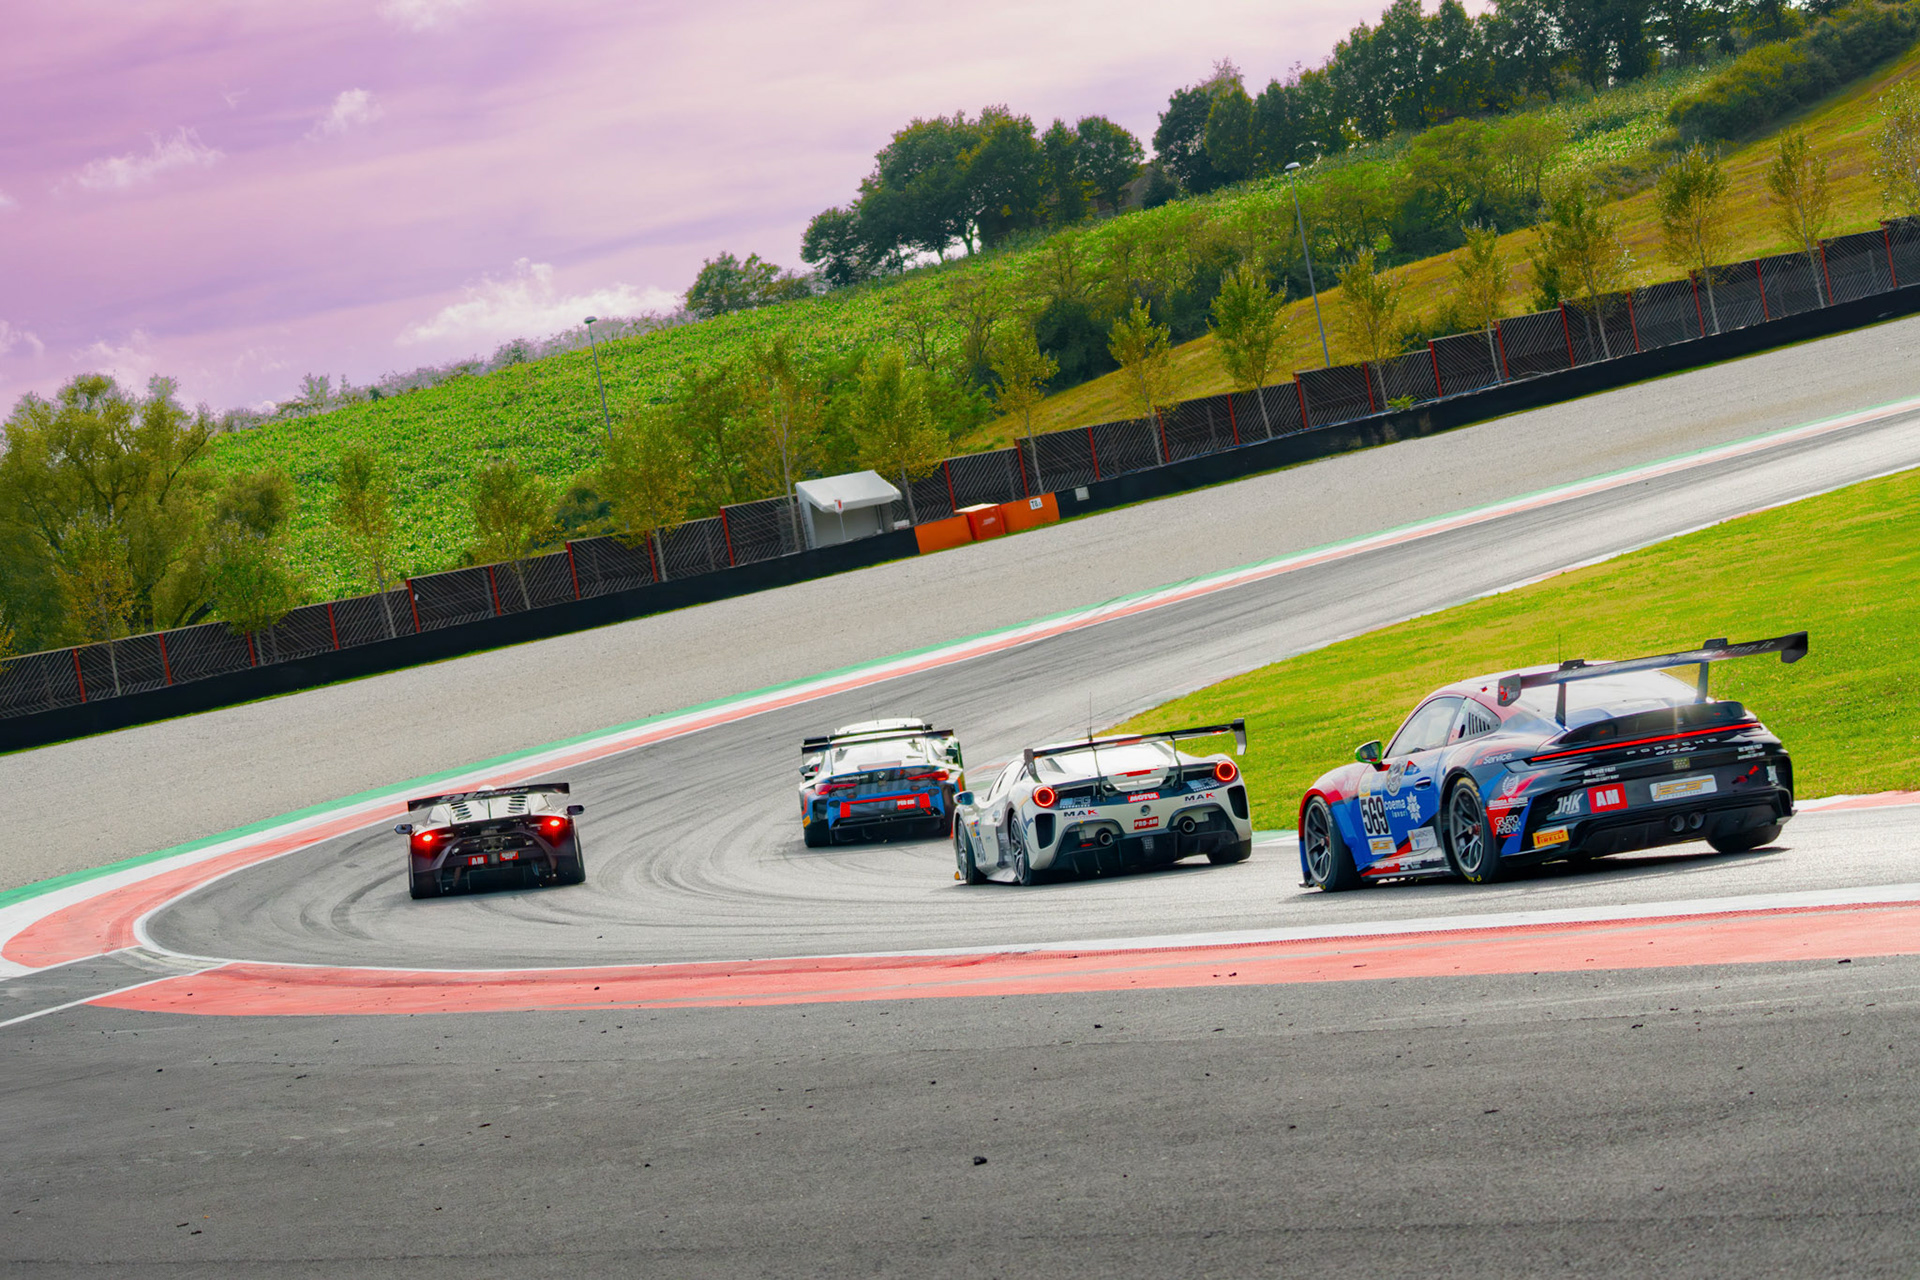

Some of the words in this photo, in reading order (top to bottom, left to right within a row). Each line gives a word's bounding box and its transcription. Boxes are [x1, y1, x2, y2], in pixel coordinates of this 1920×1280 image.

[1626, 738, 1718, 755] PORSCHE
[1130, 792, 1158, 801] MOTUL
[1185, 793, 1215, 802] MAK
[1595, 789, 1620, 807] AM
[1063, 809, 1098, 817] MAK
[1360, 796, 1389, 835] 569
[1134, 819, 1159, 828] PRO-AM
[1536, 829, 1565, 845] PIRELLI
